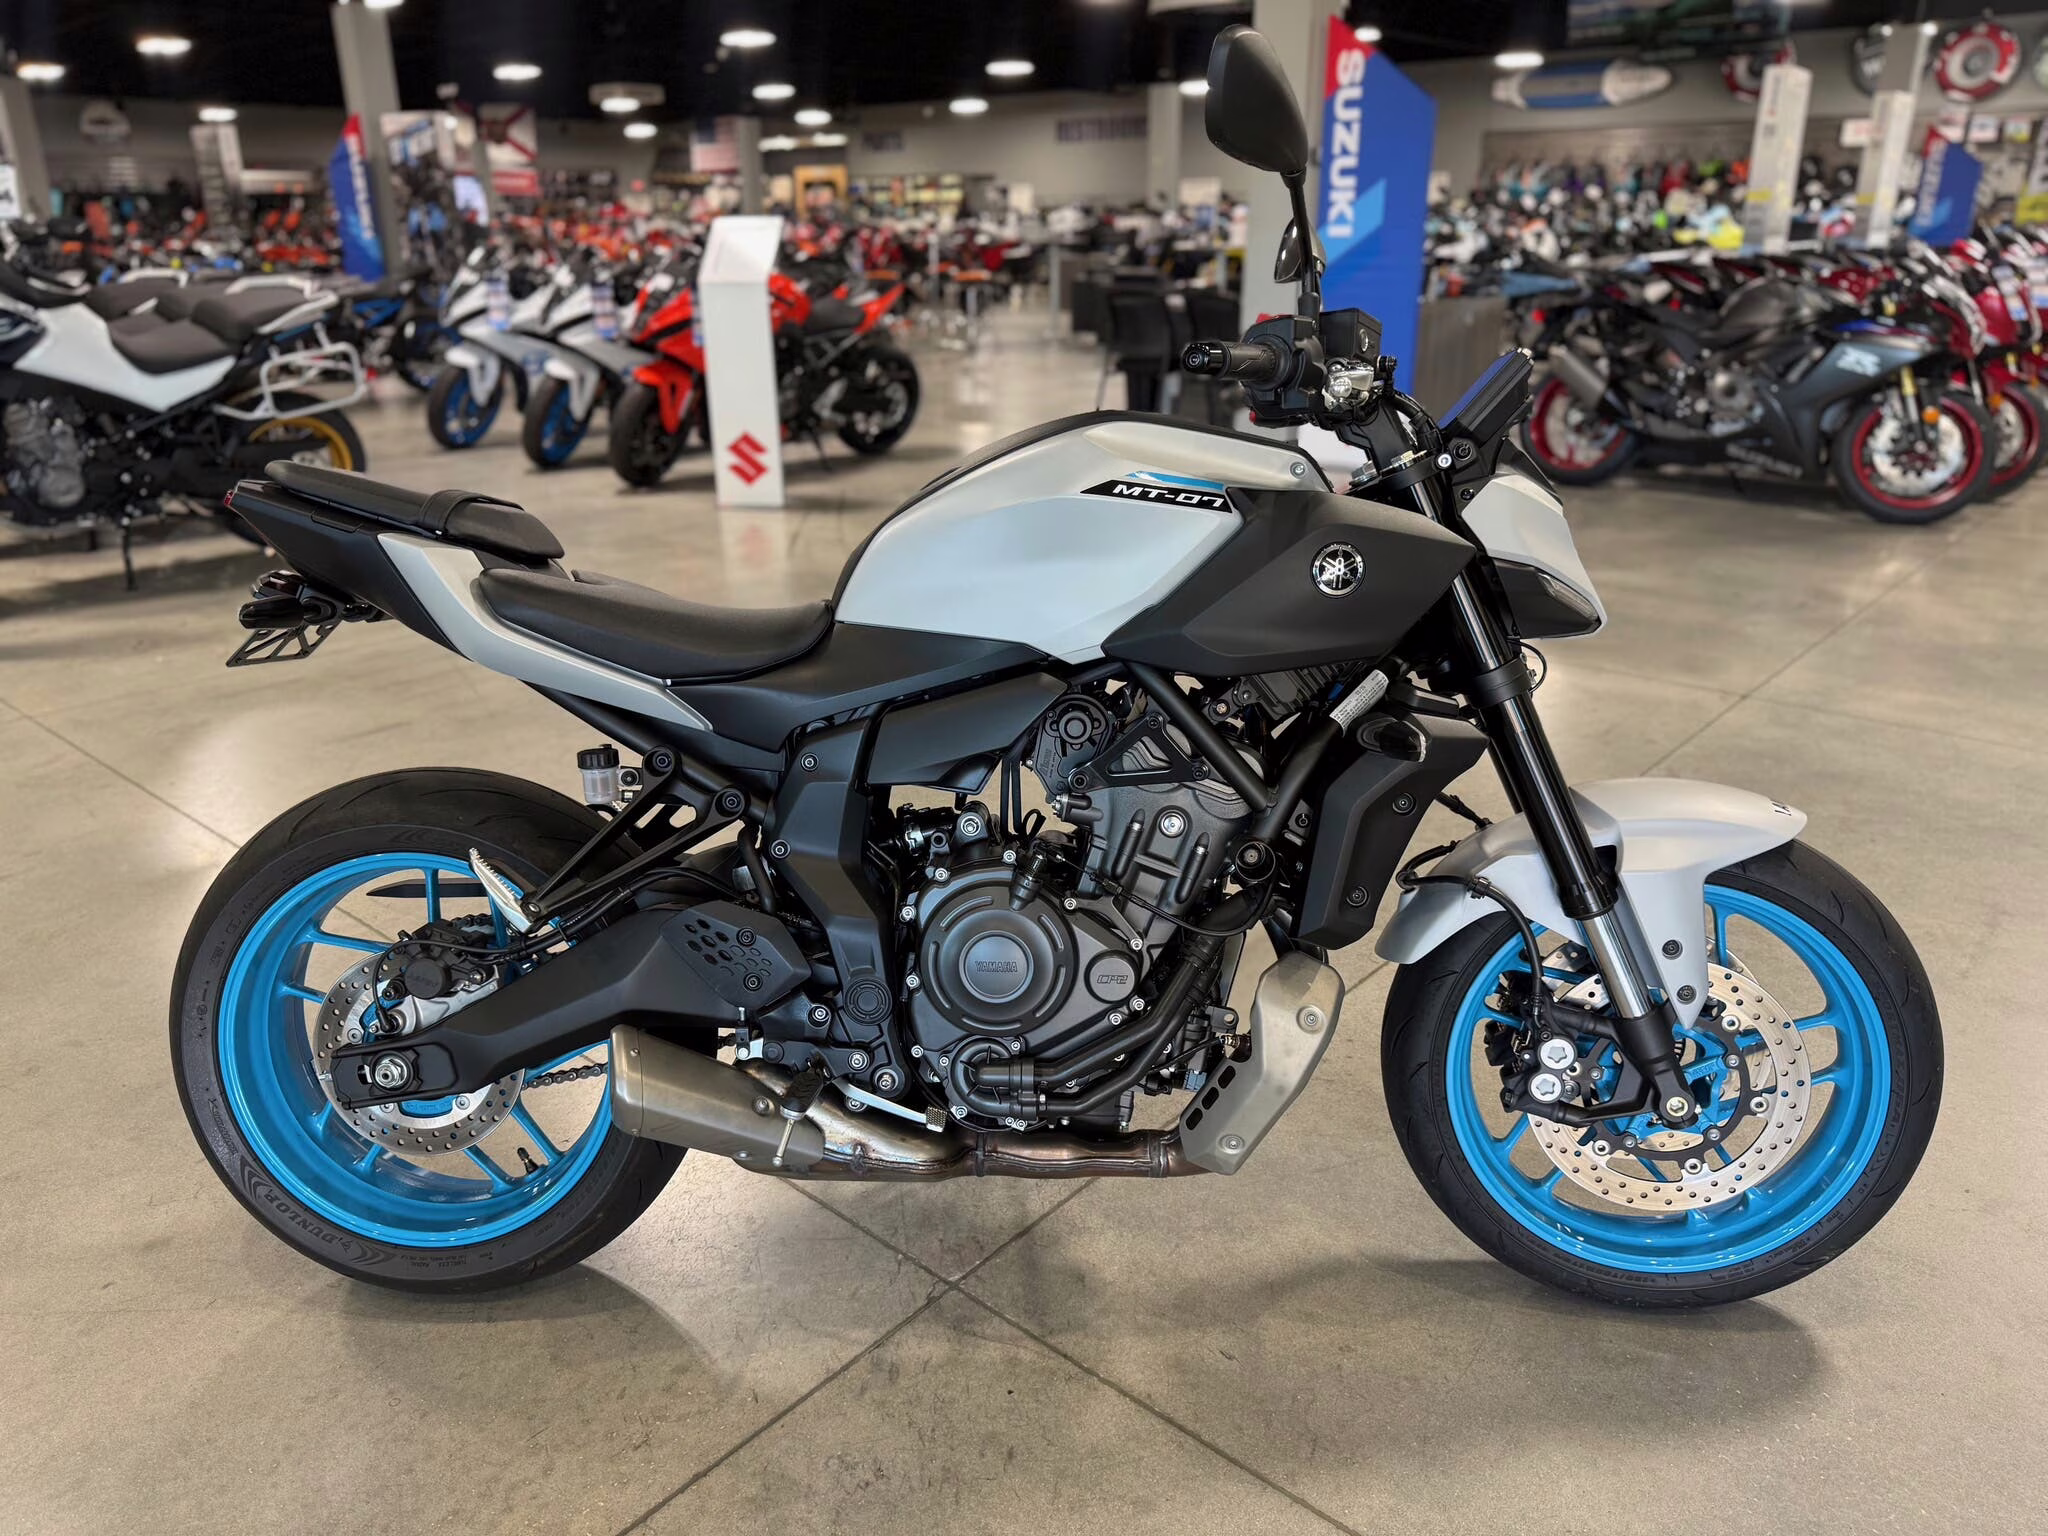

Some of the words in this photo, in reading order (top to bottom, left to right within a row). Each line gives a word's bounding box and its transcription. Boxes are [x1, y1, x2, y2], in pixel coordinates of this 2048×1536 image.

[1326, 48, 1367, 239] SUZUKI
[1112, 483, 1225, 508] MT-07
[975, 960, 1019, 973] YAMAHA
[263, 1188, 341, 1245] DUNLOP
